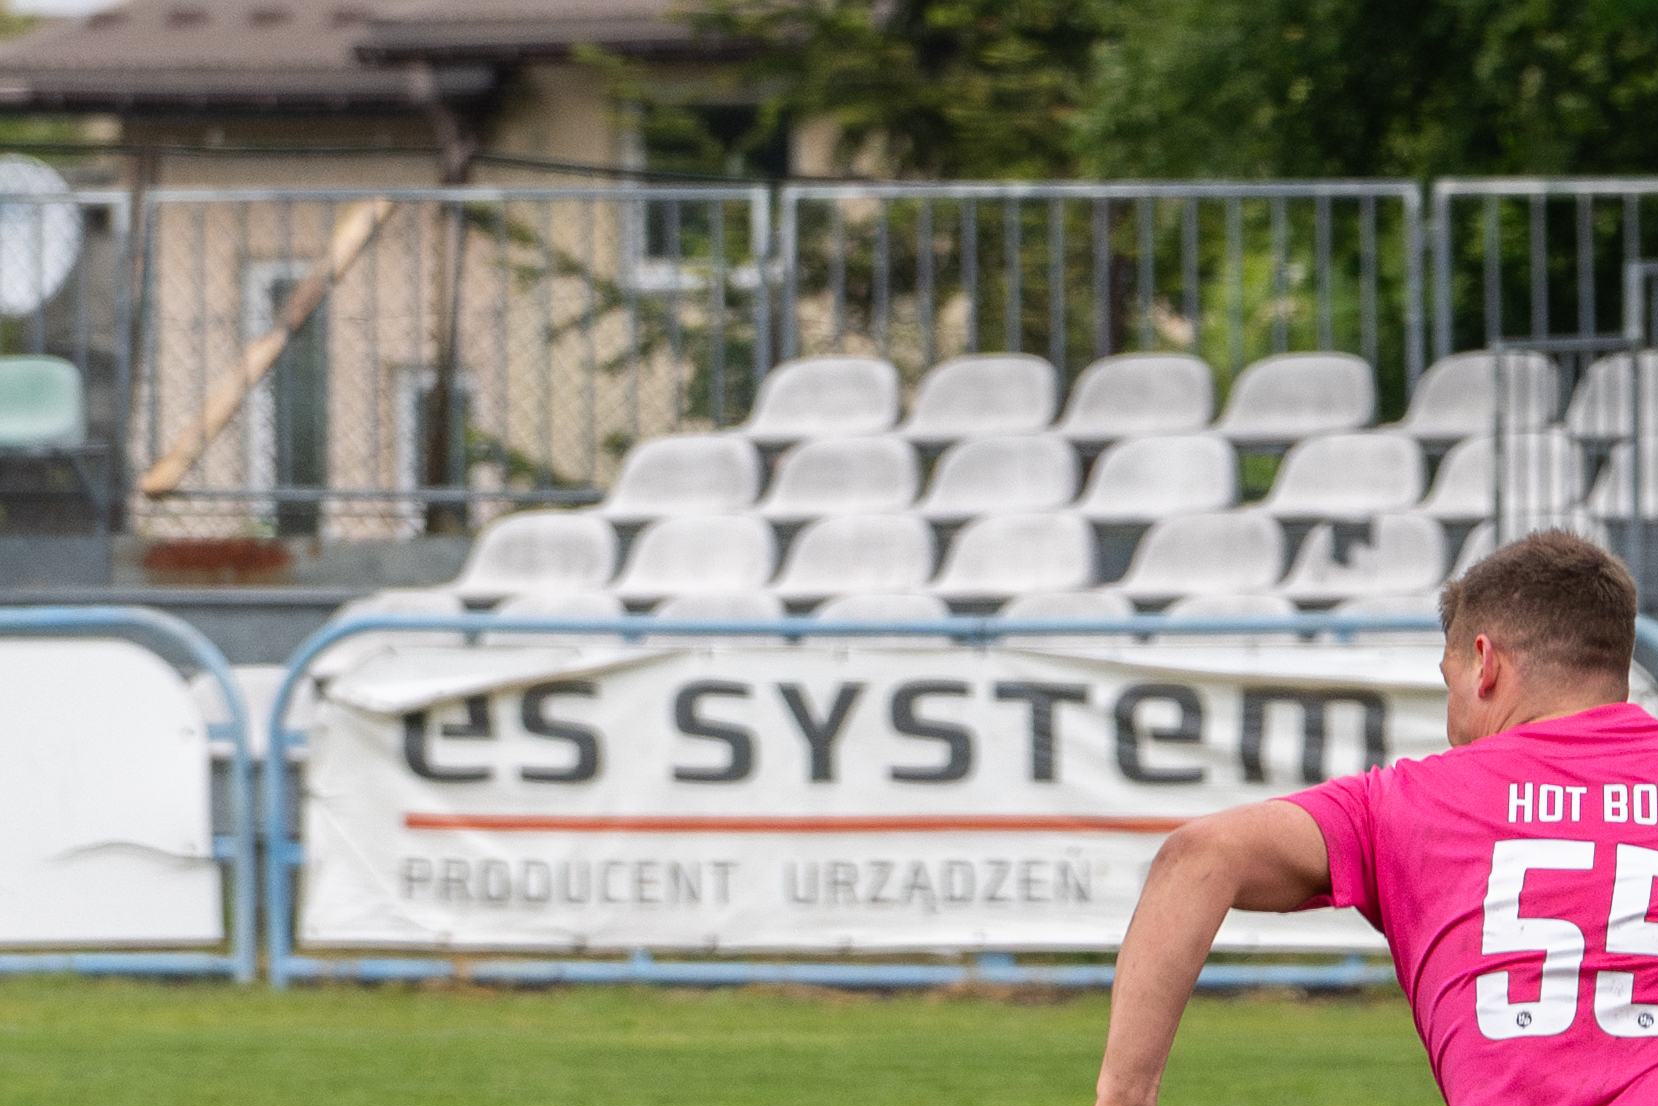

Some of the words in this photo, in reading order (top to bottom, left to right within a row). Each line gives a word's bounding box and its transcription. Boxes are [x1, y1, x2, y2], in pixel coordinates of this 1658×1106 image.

[1508, 782, 1587, 823] HOT
[401, 855, 737, 905] PRODUCENT
[783, 846, 1094, 914] URZĄDZEŃ
